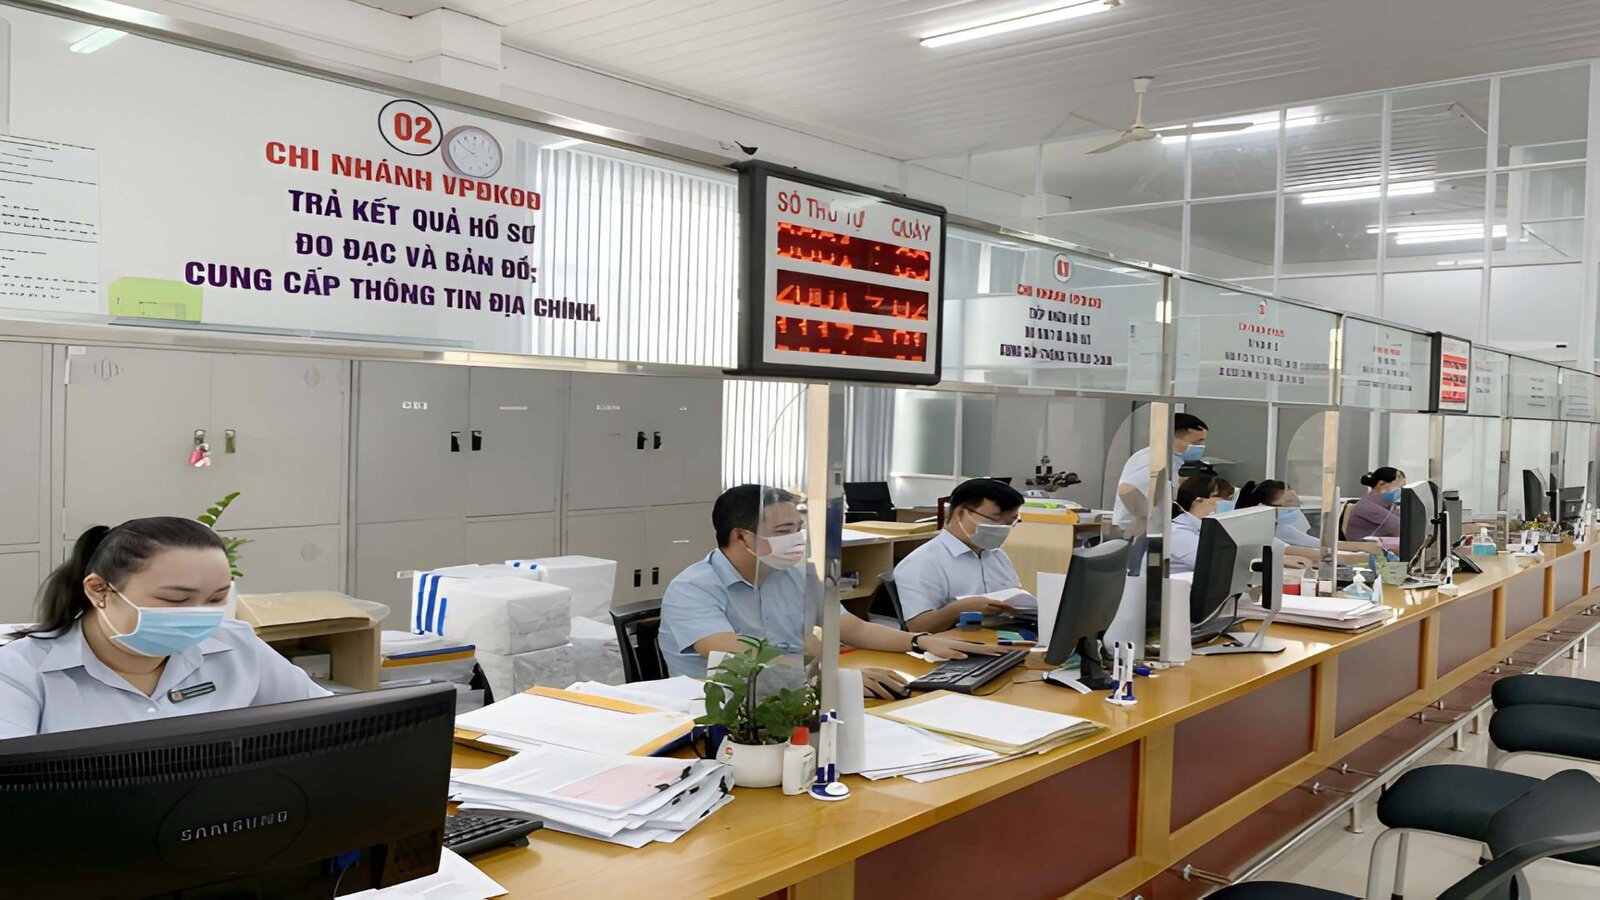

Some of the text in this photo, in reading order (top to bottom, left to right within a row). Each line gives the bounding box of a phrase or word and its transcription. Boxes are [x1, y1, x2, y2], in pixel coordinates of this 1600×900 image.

[393, 112, 433, 145] 02
[265, 141, 319, 172] CHI
[331, 153, 432, 192] NHÁNH
[352, 197, 401, 226] KẾT
[507, 223, 536, 244] SƠ
[296, 232, 334, 257] ĐO
[343, 238, 397, 267] ĐẠC
[406, 244, 437, 270] VÀ
[184, 261, 273, 291] CUNG
[283, 267, 341, 296] CẤP
[349, 277, 435, 306] THÔNG
[443, 288, 482, 311] TIN
[488, 293, 526, 318] ĐỊA
[180, 810, 289, 842] SAMSUNG
